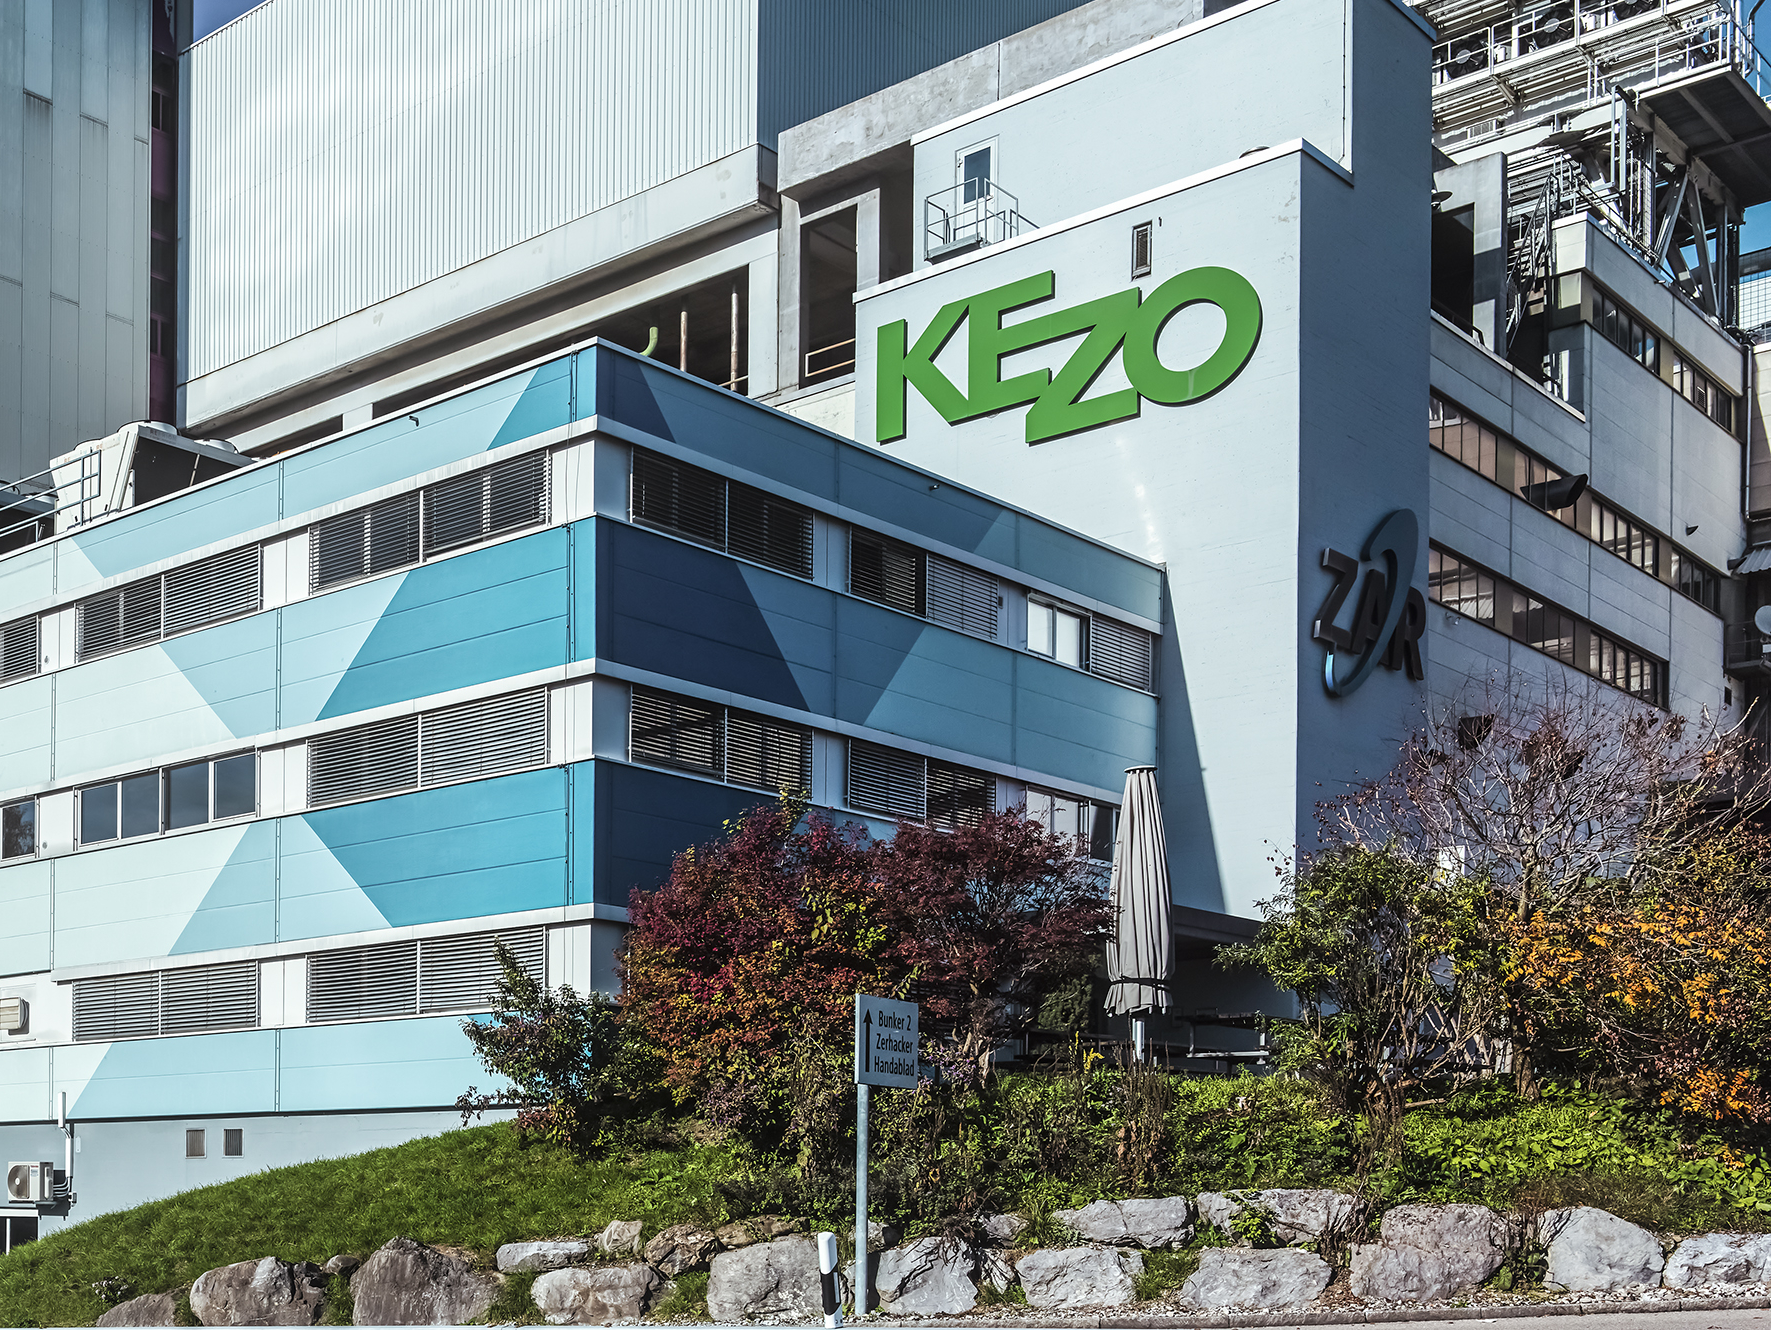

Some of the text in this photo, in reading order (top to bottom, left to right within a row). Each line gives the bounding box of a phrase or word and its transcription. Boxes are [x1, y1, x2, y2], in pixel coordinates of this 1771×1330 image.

[876, 266, 1264, 447] KEZO
[1313, 547, 1427, 681] ZAR
[878, 1010, 912, 1031] Bunker 2
[876, 1033, 914, 1054] Zerhacker
[874, 1056, 915, 1077] Handablad
